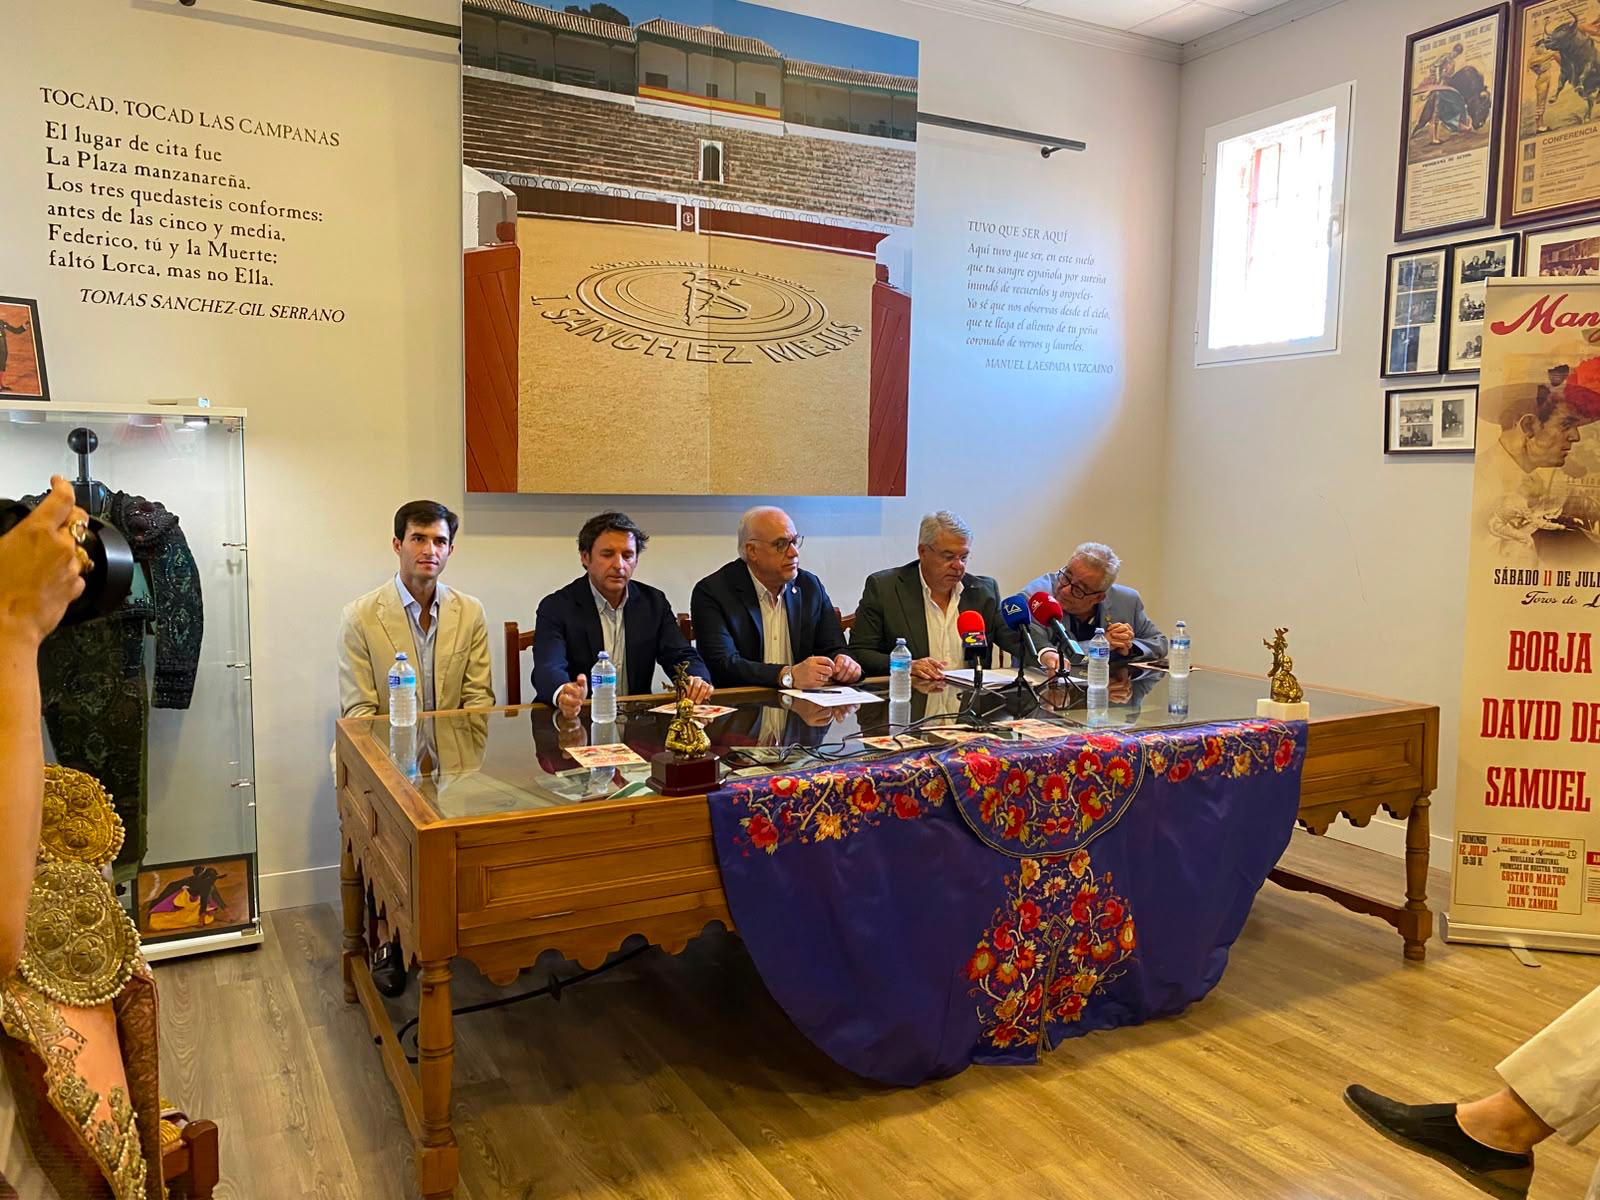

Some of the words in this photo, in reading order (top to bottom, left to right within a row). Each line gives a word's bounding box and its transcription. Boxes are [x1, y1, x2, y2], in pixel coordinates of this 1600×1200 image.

[123, 100, 194, 125] TOCAD
[199, 111, 235, 132] LAS
[239, 118, 340, 147] CAMPANAS
[45, 121, 67, 140] El
[75, 126, 122, 150] lugar
[129, 134, 149, 152] de
[156, 140, 188, 157] cita
[195, 144, 222, 162] fue
[1542, 127, 1598, 146] CONFERENCIA
[46, 147, 70, 167] La
[77, 151, 127, 175] Plaza
[134, 164, 251, 190] manzanareña.
[47, 173, 83, 193] Los
[90, 181, 124, 199] tres
[131, 187, 223, 211] quedasteis
[228, 200, 323, 222] conformes:
[47, 204, 95, 220] antes
[101, 208, 123, 224] de
[130, 209, 153, 226] las
[160, 214, 207, 233] cinco
[213, 222, 223, 238] y
[968, 220, 996, 233] TUVO
[998, 225, 1019, 239] QUE
[1021, 228, 1040, 239] SER
[1042, 229, 1069, 244] AQUÍ
[48, 224, 138, 251] Federico,
[144, 237, 162, 252] tú
[169, 242, 179, 258] y
[187, 239, 202, 256] la
[208, 241, 278, 264] Muerte;
[992, 246, 1011, 257] tuvo
[1013, 249, 1029, 262] que
[1046, 254, 1056, 262] en
[1058, 255, 1073, 264] este
[1075, 254, 1095, 266] suelo
[49, 250, 96, 270] faltó
[102, 254, 160, 277] Lorca,
[167, 264, 201, 280] mas
[207, 269, 228, 283] no
[234, 267, 274, 286] Ella.
[967, 263, 983, 276] que
[985, 264, 995, 274] tu
[997, 265, 1025, 281] sangre
[1027, 268, 1062, 283] española
[1063, 273, 1079, 285] por
[1080, 273, 1106, 285] sureña
[967, 280, 999, 293] inundó
[1000, 281, 1010, 293] de
[1012, 285, 1050, 297] recuerdos
[1051, 290, 1058, 300] y
[80, 288, 148, 308] TOMAS
[151, 295, 265, 317] SANCHEZ-GIL
[269, 305, 345, 323] SERRANO
[967, 298, 977, 309] Yo
[979, 299, 988, 310] sé
[990, 302, 1005, 315] que
[1008, 303, 1022, 312] nos
[1023, 301, 1058, 315] observas
[1060, 303, 1080, 317] desde
[1082, 305, 1091, 318] el
[966, 319, 983, 331] que
[984, 319, 992, 328] te
[994, 317, 1015, 333] llega
[1017, 318, 1026, 330] el
[1026, 319, 1054, 332] aliento
[1056, 320, 1066, 333] de
[1067, 324, 1077, 334] tu
[1078, 325, 1098, 339] peña
[966, 334, 1005, 346] coronado
[1007, 335, 1017, 347] de
[1019, 339, 1043, 349] versos
[1044, 343, 1051, 353] y
[985, 358, 1025, 370] MANUEL
[1026, 359, 1070, 373] LAESPADA
[1494, 566, 1540, 586] SÁBADO
[1556, 570, 1571, 587] DE
[1521, 590, 1557, 605] Toros
[1562, 595, 1578, 605] de
[1507, 630, 1592, 673] BORJA
[1480, 698, 1561, 741] DAVID
[1485, 766, 1591, 812] SAMUEL
[1468, 845, 1488, 857] JULIO
[1501, 871, 1534, 883] GUSTAVO
[1536, 874, 1566, 886] MARTOS
[1507, 884, 1530, 896] JAIME
[1507, 896, 1526, 908] JUAN
[1528, 898, 1558, 911] ZAMORA
